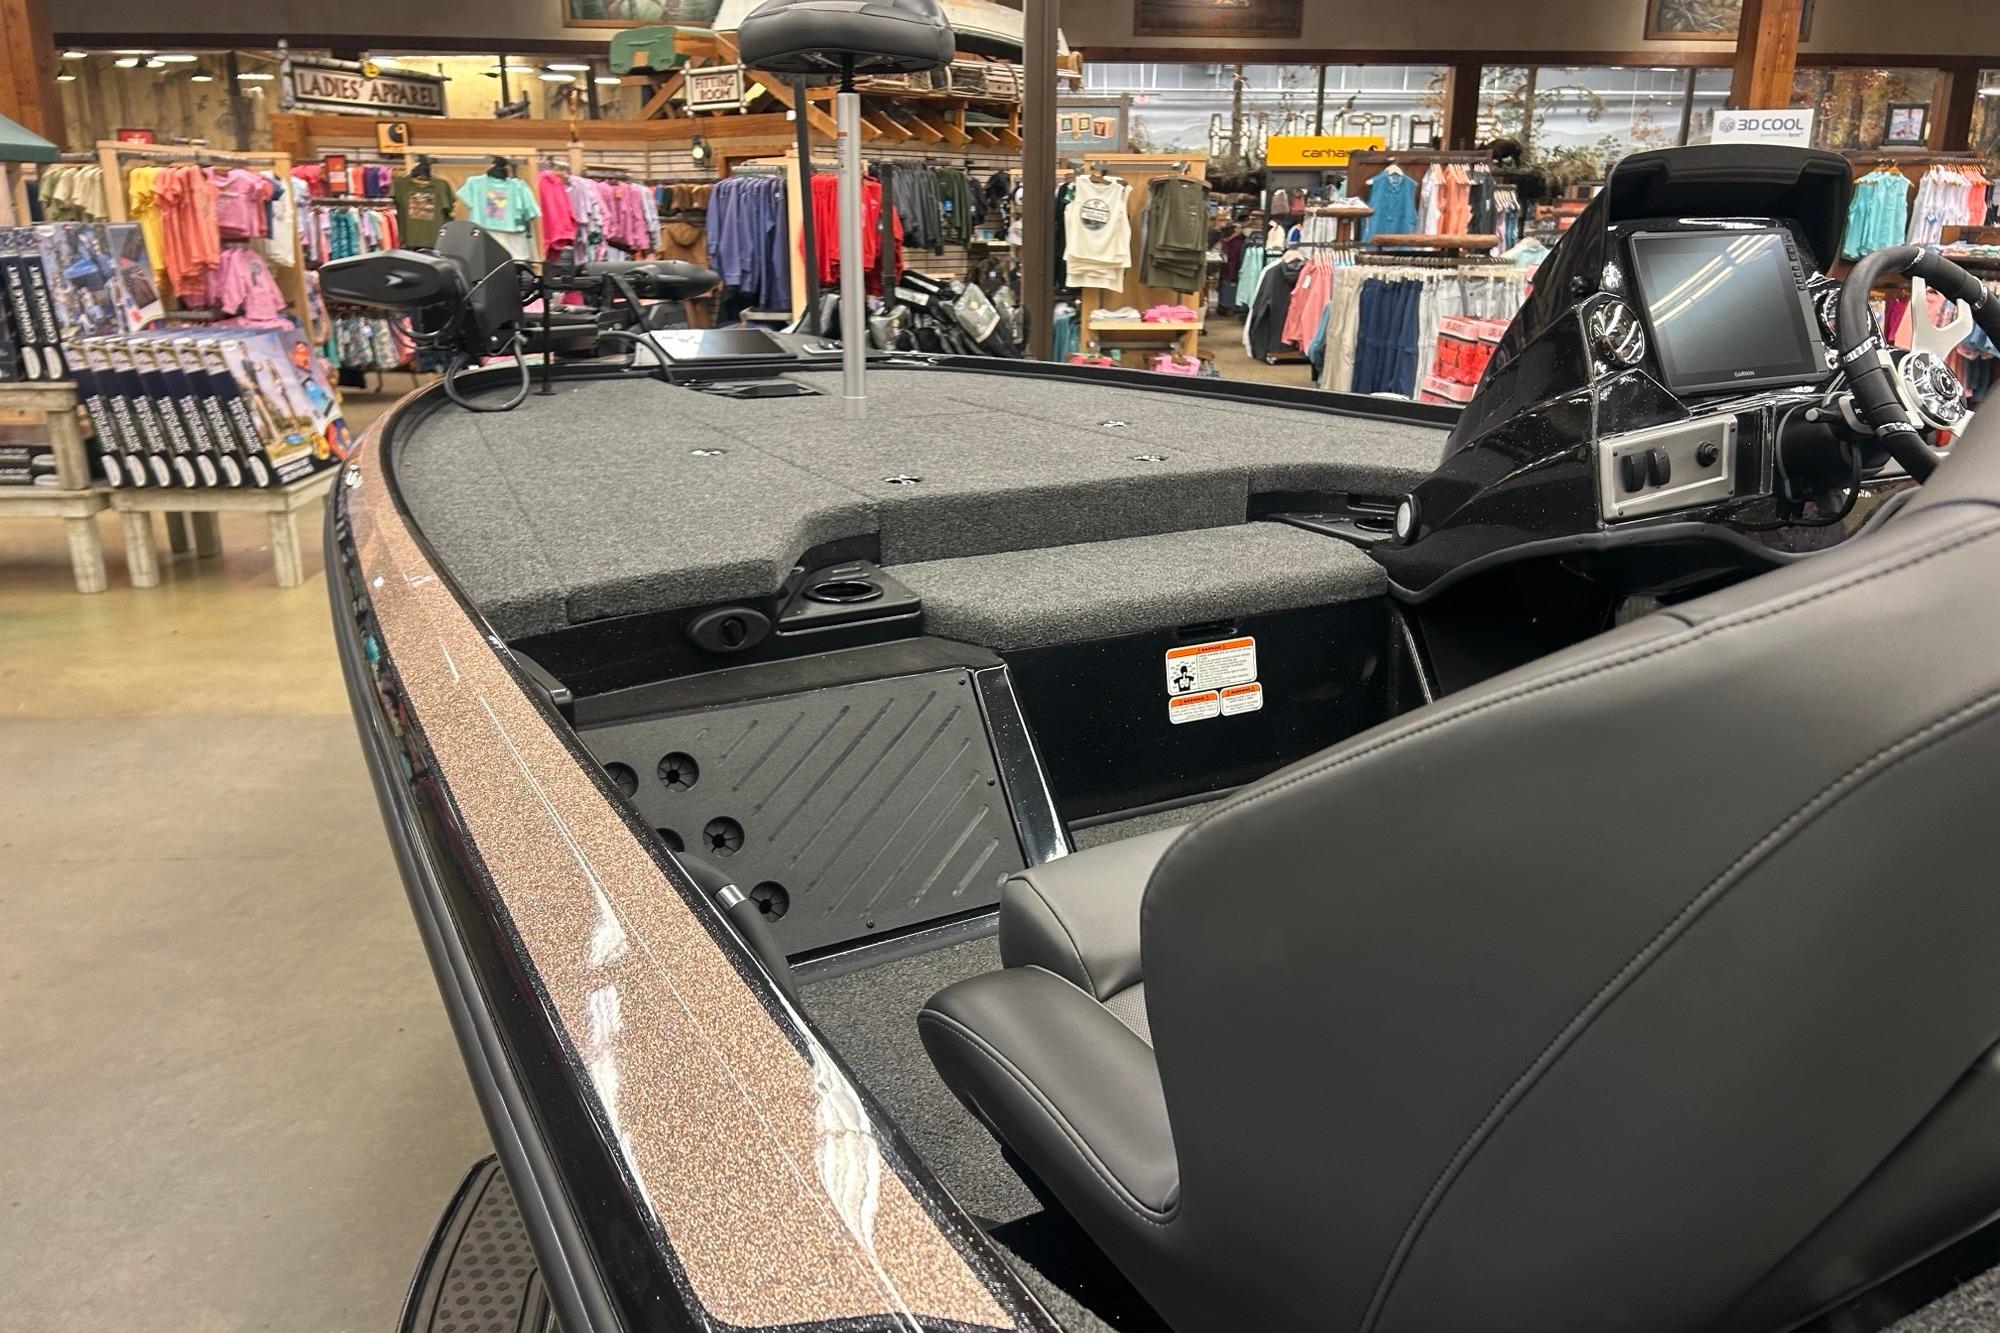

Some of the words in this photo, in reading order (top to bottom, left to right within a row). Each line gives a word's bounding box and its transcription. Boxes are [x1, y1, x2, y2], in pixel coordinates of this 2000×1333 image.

[695, 74, 735, 88] FITTING
[299, 73, 364, 100] LADIES'
[369, 80, 437, 108] APPAREL
[700, 88, 730, 100] ROOM
[1738, 118, 1760, 131] 3D
[1762, 118, 1804, 131] COOL
[1302, 148, 1350, 158] carha
